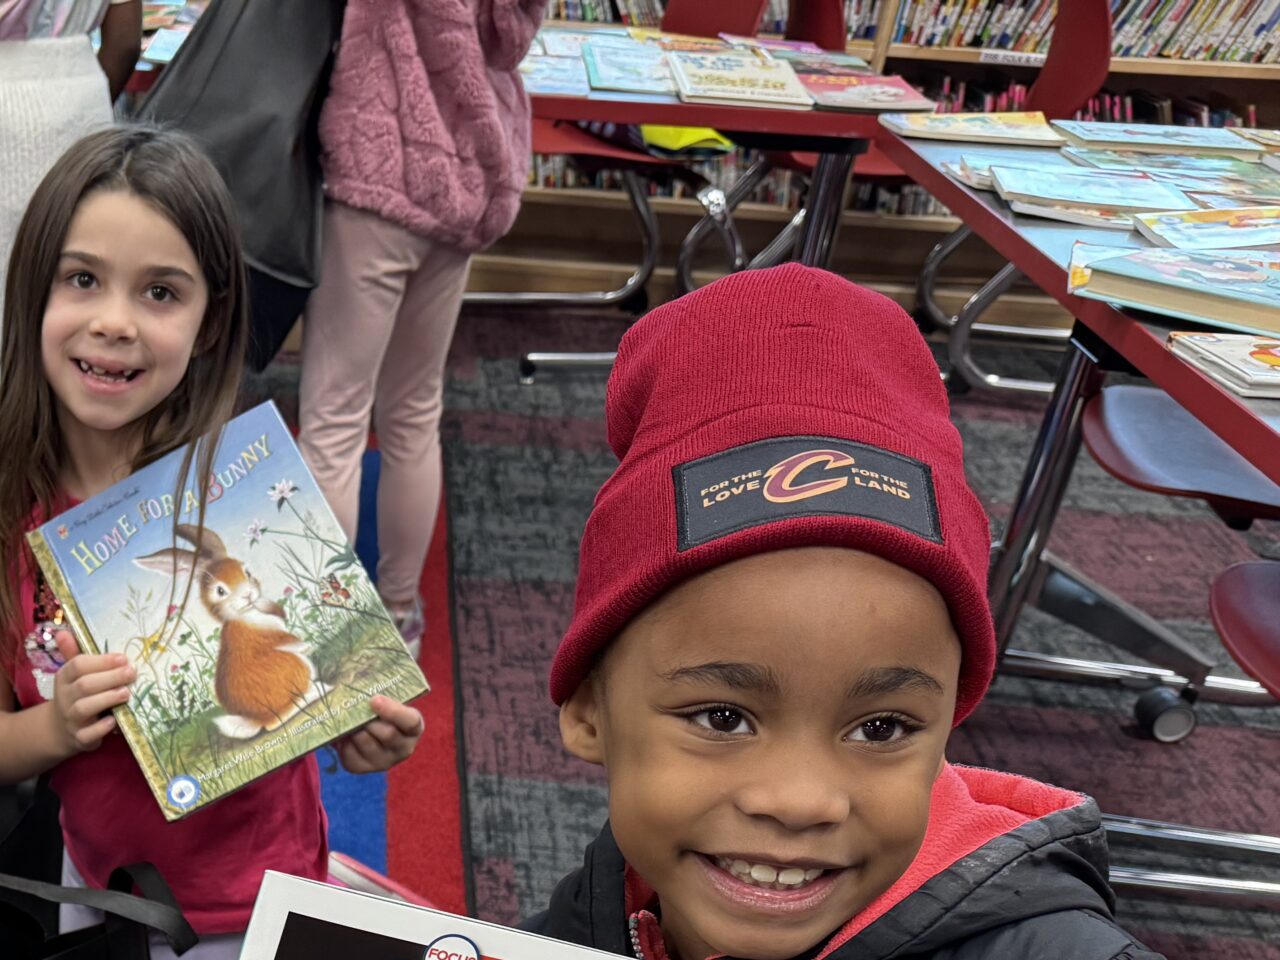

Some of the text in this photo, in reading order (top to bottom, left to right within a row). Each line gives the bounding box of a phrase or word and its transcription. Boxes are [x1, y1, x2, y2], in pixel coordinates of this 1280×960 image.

[700, 469, 762, 497] FOR THE
[851, 467, 908, 489] FOR THE
[854, 477, 911, 499] LAND
[70, 514, 138, 576] HOME
[138, 493, 174, 525] FOR
[207, 435, 272, 504] BUNNY
[702, 480, 760, 508] LOVE
